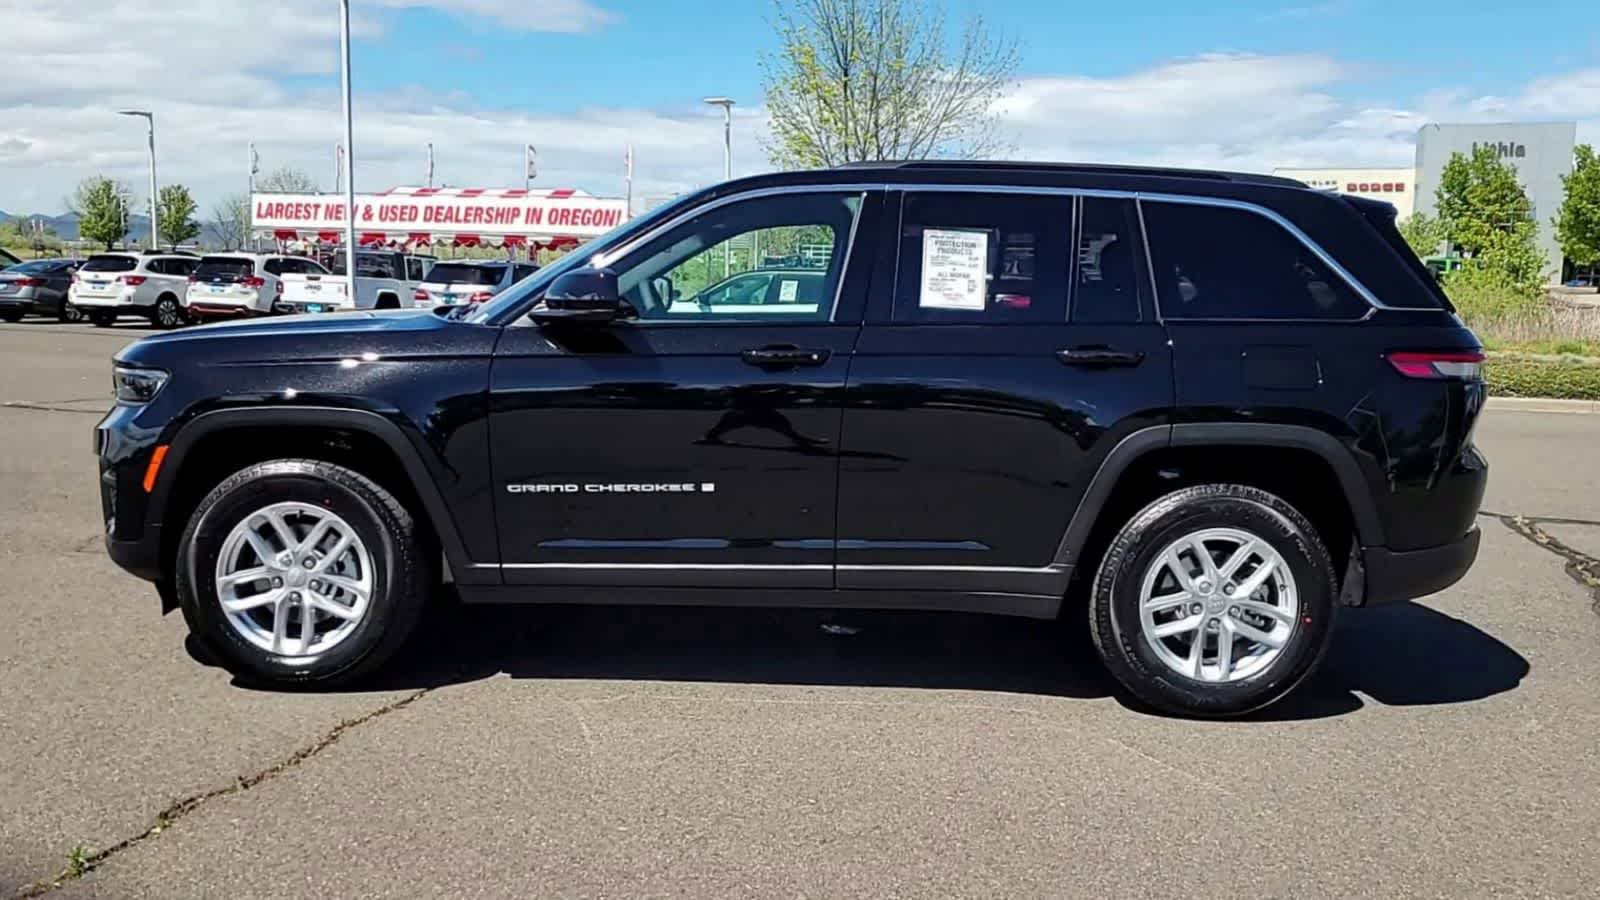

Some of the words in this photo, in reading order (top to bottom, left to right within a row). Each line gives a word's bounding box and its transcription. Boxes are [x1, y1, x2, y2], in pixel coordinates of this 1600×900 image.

[256, 202, 321, 220] LARGEST
[362, 204, 374, 221] &
[378, 204, 418, 222] USED
[423, 205, 520, 224] DEALERSHIP
[525, 207, 543, 225] IN
[548, 208, 622, 227] OREGON!
[507, 484, 579, 492] GRAND
[584, 484, 695, 492] CHEROKEE
